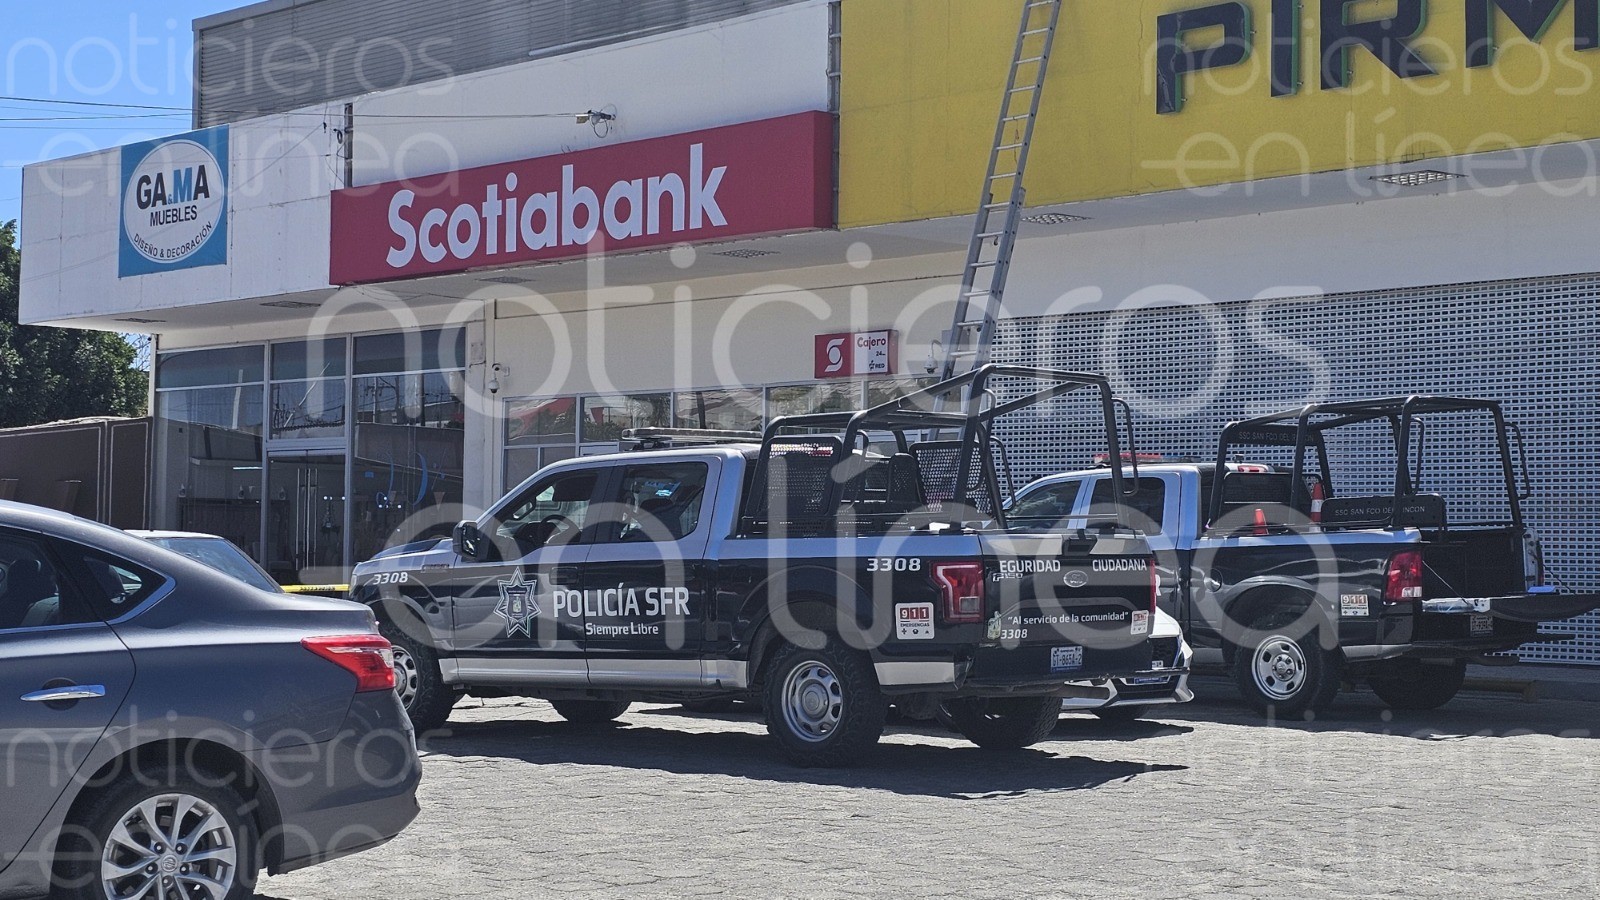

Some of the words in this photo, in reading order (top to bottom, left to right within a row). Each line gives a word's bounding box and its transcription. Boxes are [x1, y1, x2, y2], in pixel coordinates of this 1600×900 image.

[386, 142, 728, 268] Scotiabank
[149, 204, 198, 227] MUEBLES
[133, 233, 158, 257] DISEÑO
[159, 248, 165, 258] &
[166, 221, 212, 258] DECORACIÓN
[856, 336, 887, 350] Cajero
[865, 557, 921, 572] 3308
[1092, 558, 1148, 572] CIUDADANA
[372, 571, 408, 586] 3308
[553, 582, 640, 618] POLICÍA
[645, 586, 690, 616] SFR
[1342, 595, 1365, 604] 911
[901, 608, 927, 619] 911
[1023, 614, 1058, 625] servicio
[1059, 613, 1070, 623] de
[1071, 613, 1080, 623] la
[586, 622, 630, 637] Siempre
[630, 621, 659, 636] Libre
[1000, 628, 1028, 639] 3308
